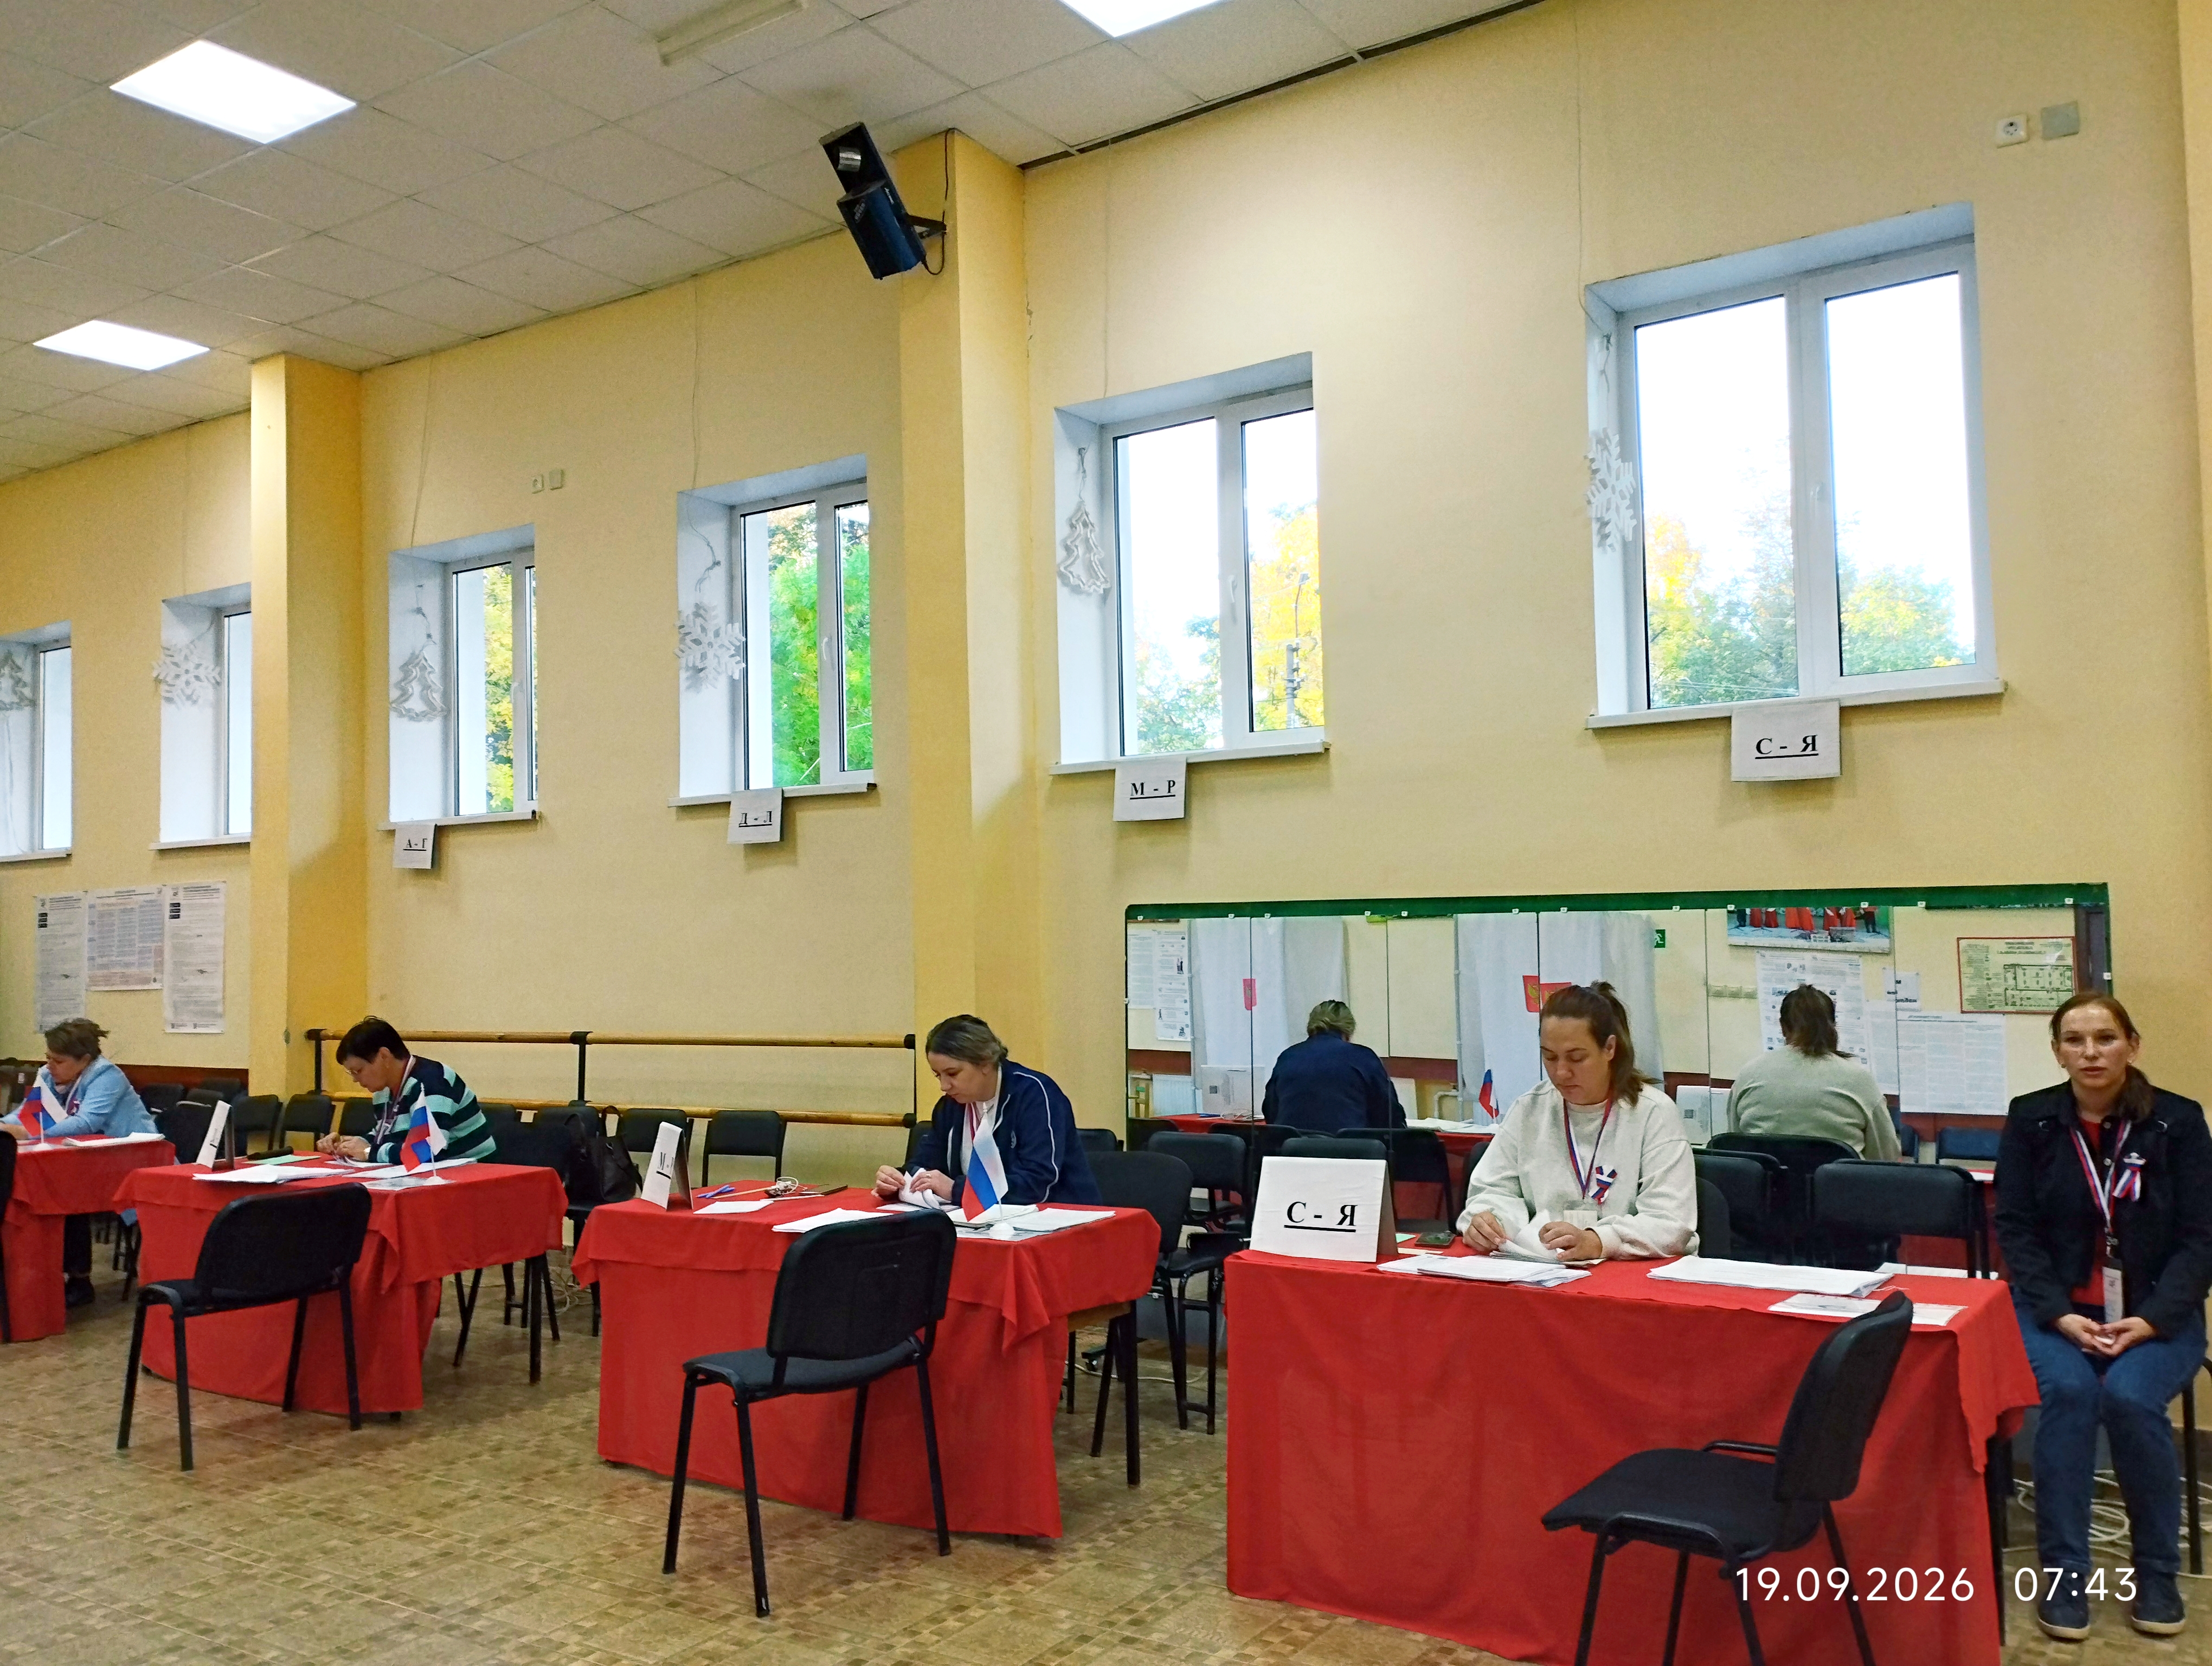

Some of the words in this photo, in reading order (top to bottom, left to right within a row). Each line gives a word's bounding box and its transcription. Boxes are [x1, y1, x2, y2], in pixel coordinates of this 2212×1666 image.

[1756, 738, 1772, 754] С
[1799, 734, 1818, 752] Я
[1130, 782, 1146, 796] М
[1166, 780, 1176, 793] Р
[1287, 1201, 1307, 1223] С
[1335, 1204, 1358, 1227] Я
